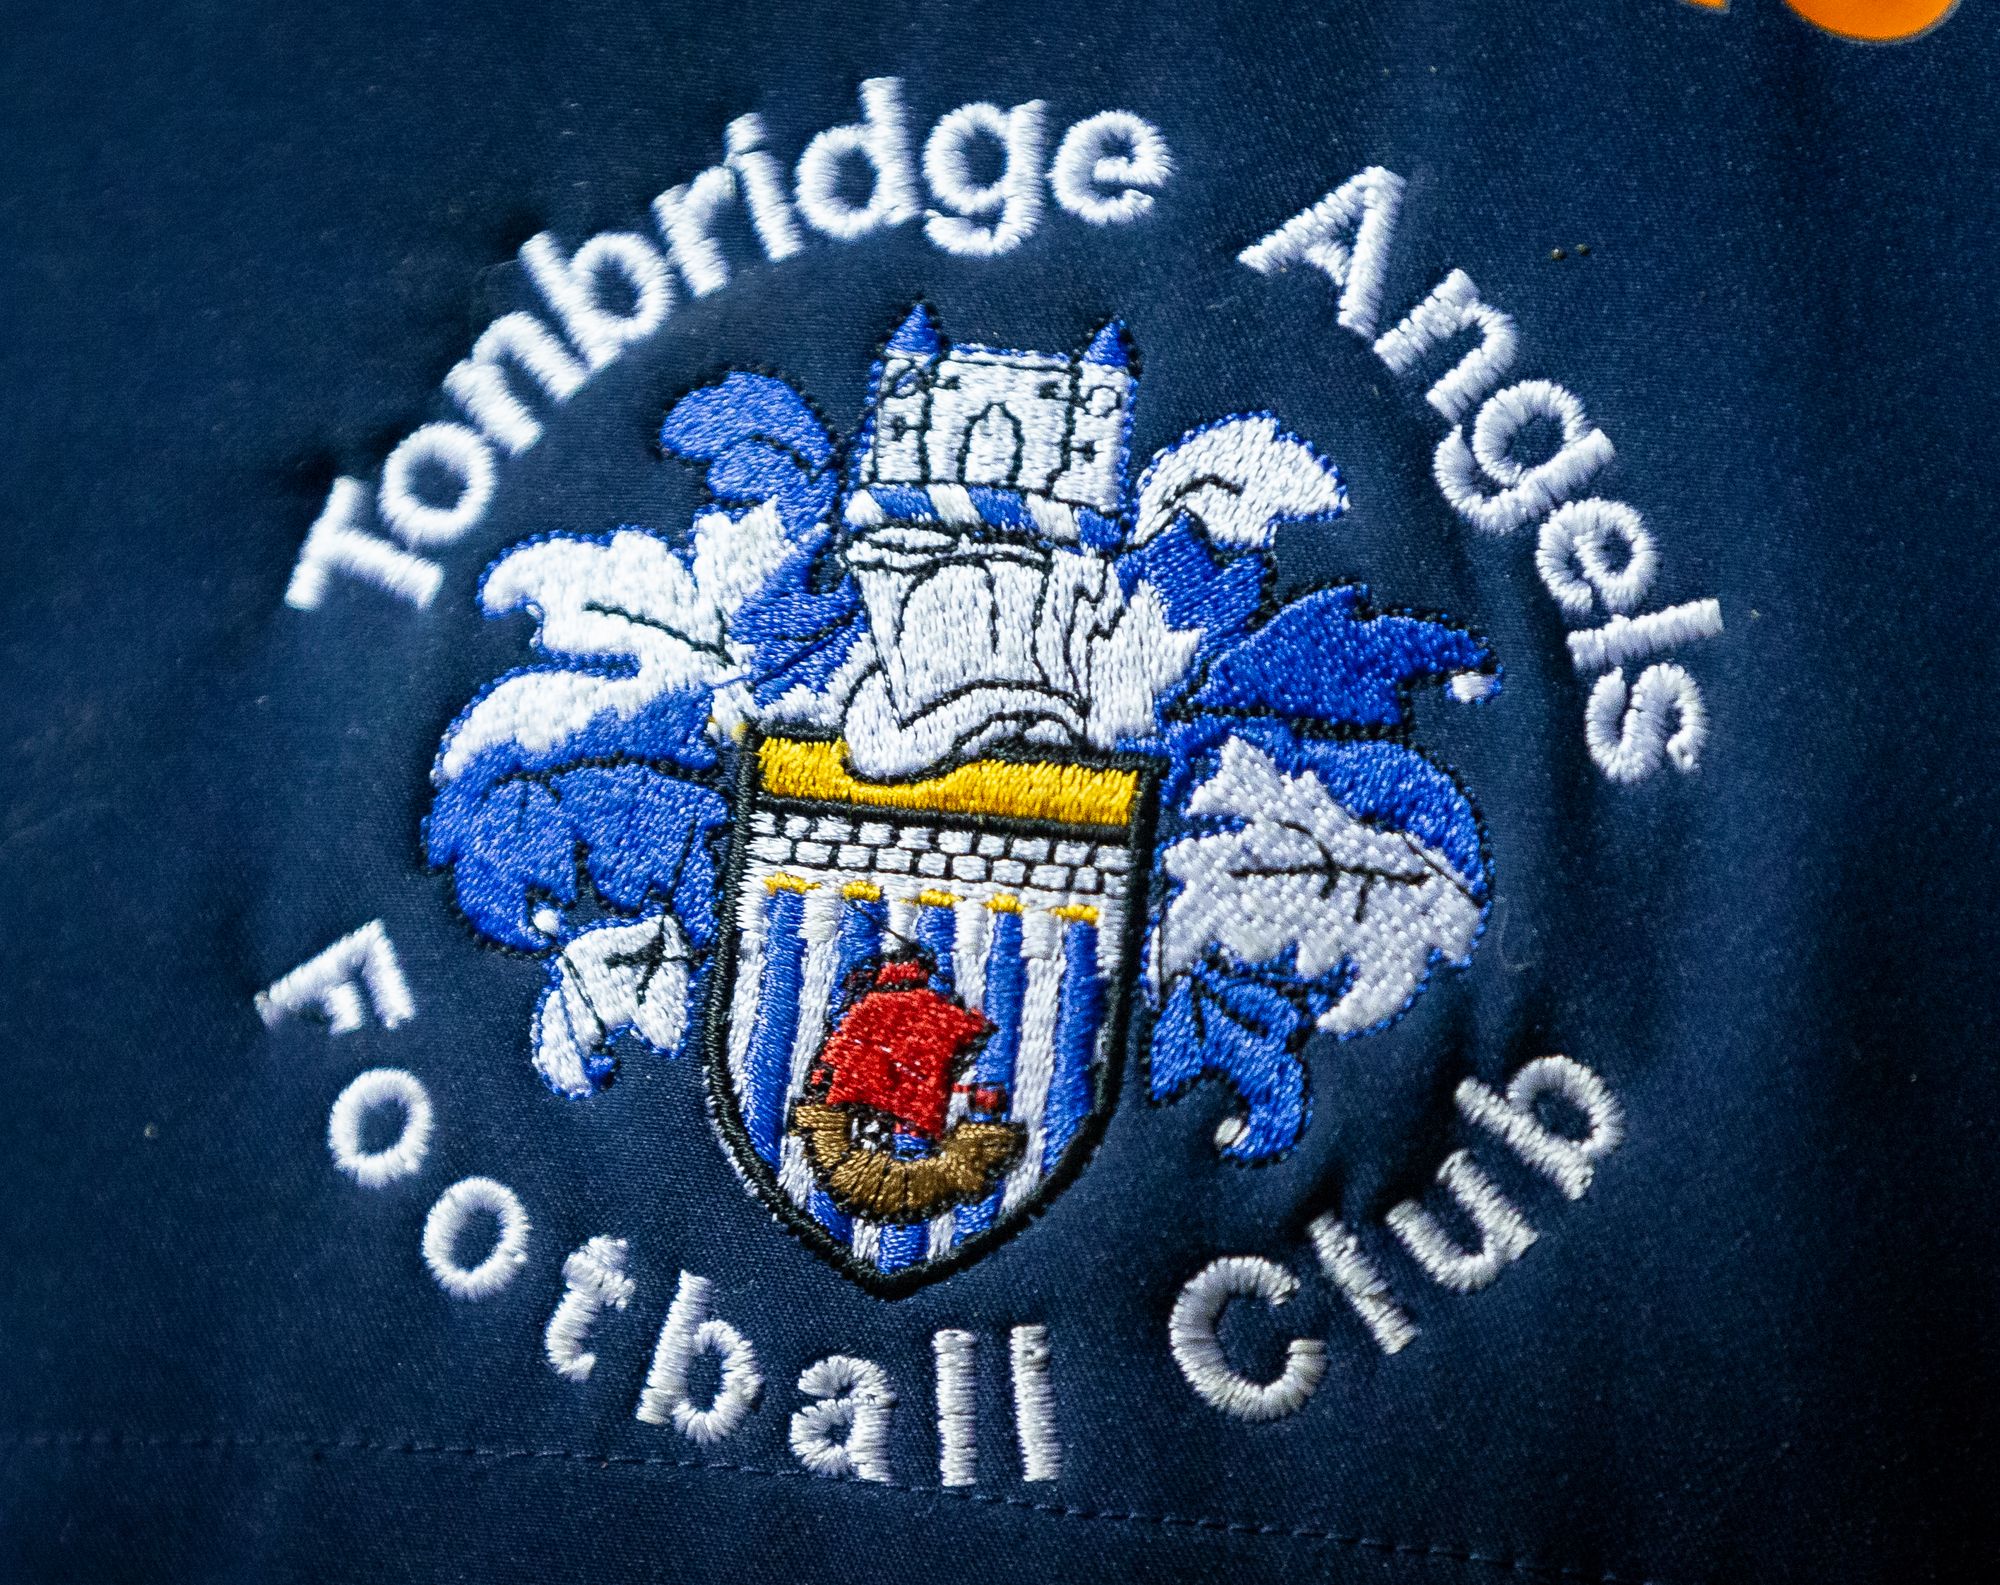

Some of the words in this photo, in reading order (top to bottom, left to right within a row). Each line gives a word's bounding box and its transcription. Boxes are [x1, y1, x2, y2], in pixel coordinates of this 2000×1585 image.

[284, 76, 1173, 612] Tonbridge
[1238, 164, 1722, 785] Angels
[256, 922, 1063, 1487] Football
[1169, 1054, 1625, 1420] Club
